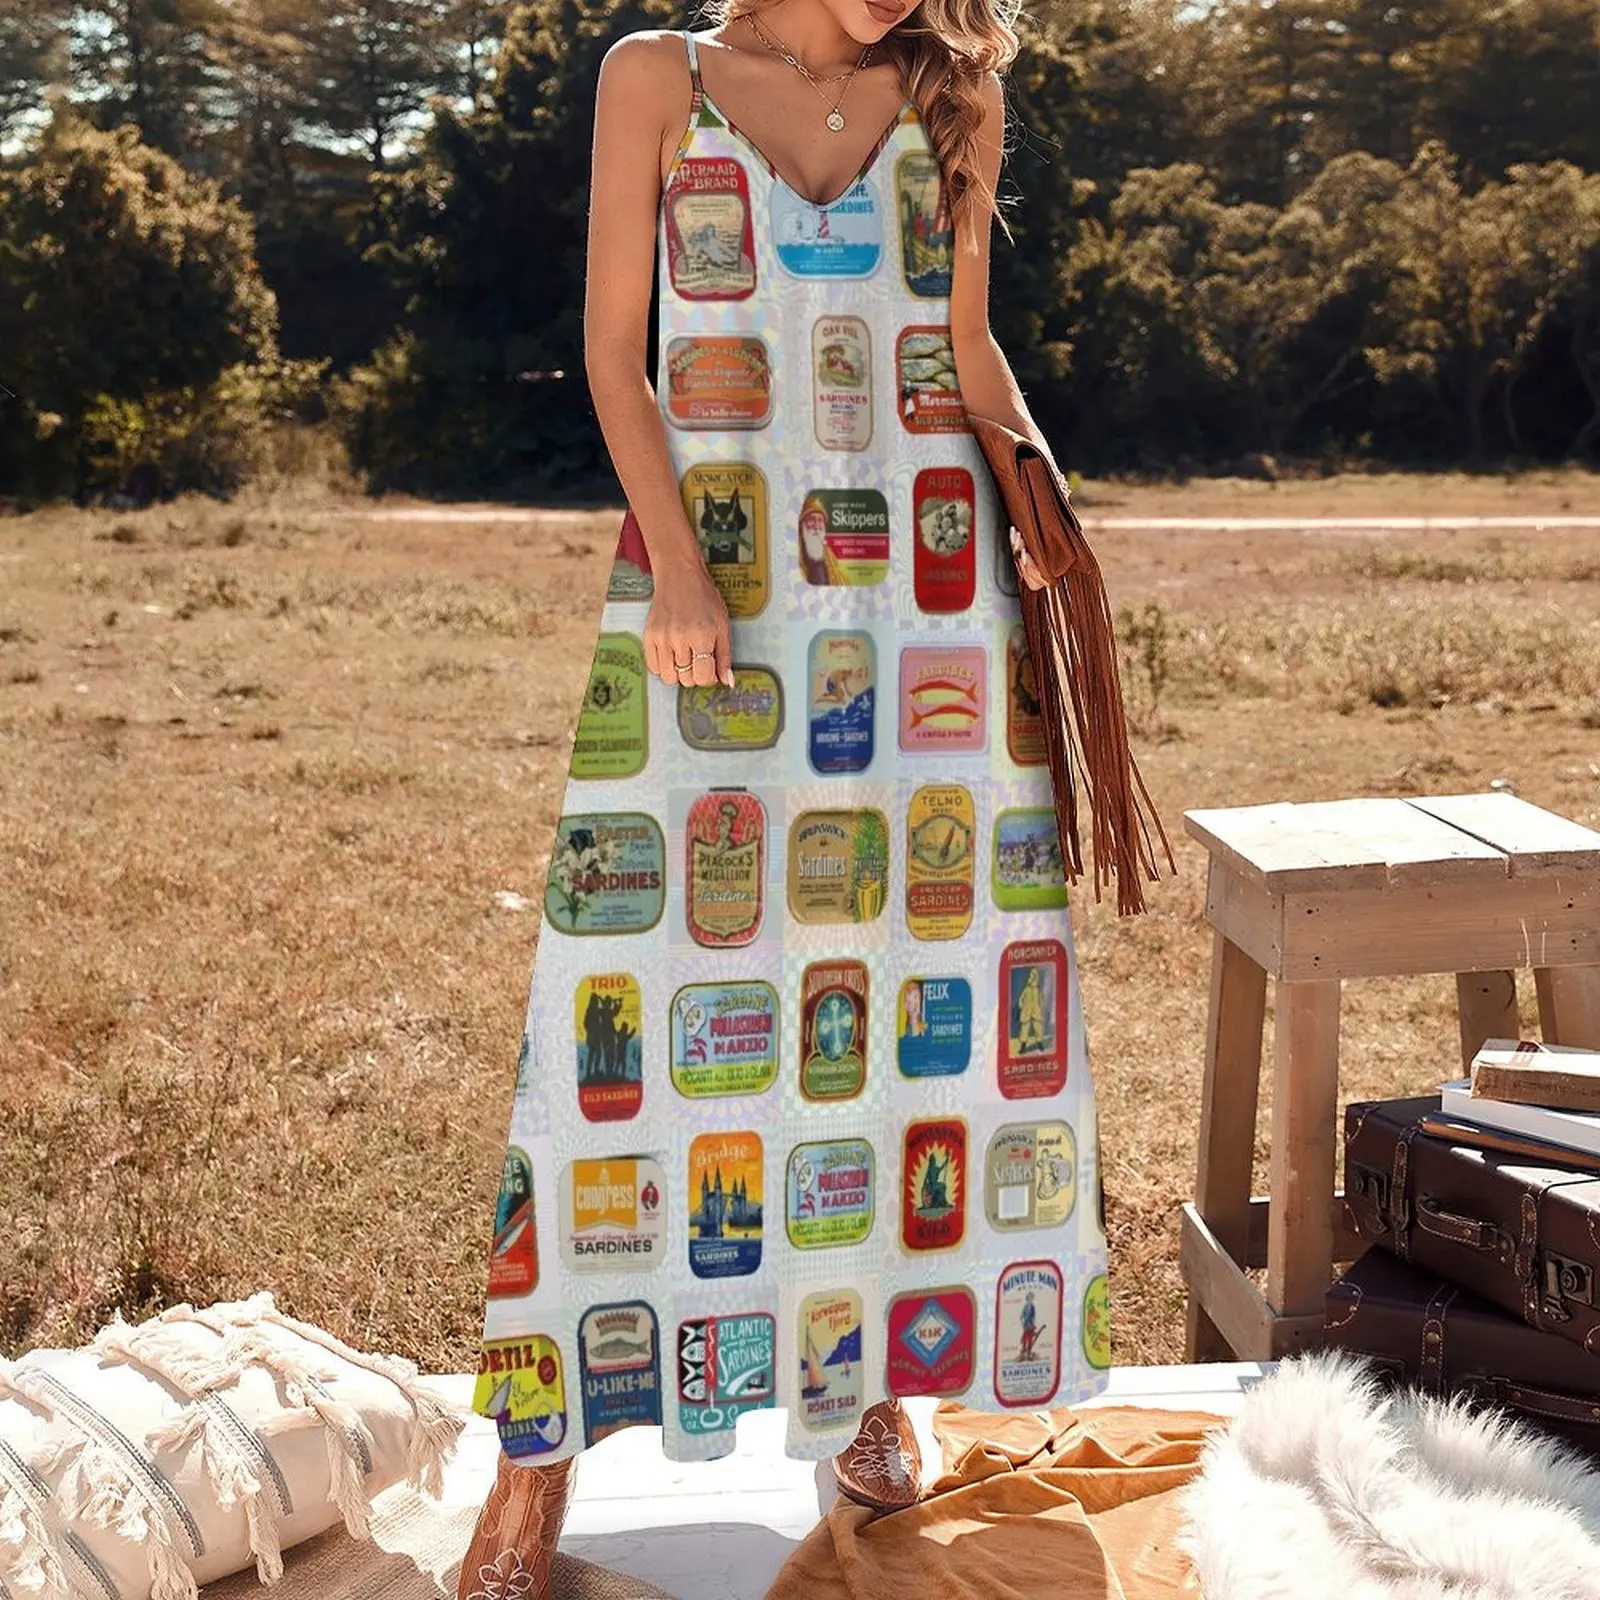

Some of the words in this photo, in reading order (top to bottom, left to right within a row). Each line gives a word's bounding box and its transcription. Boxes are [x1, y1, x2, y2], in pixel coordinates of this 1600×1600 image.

[694, 177, 738, 189] BRAND
[831, 510, 886, 529] Skippers
[921, 795, 963, 806] TELMO
[798, 850, 846, 877] Sardines
[572, 871, 661, 893] SARDINES
[911, 895, 969, 907] SARDINES
[589, 975, 628, 990] TRIO
[923, 982, 949, 1001] FELIX
[1003, 1060, 1059, 1075] SARDINES
[695, 1142, 749, 1168] Bridge
[575, 1183, 635, 1215] congress
[574, 1239, 653, 1255] SARDINES
[1002, 1270, 1036, 1293] MINUTE
[1038, 1271, 1057, 1291] MAN
[719, 1318, 771, 1338] ATLANTIC
[918, 1325, 942, 1339] KIK
[478, 1344, 537, 1375] ORTIZ
[717, 1340, 773, 1388] SARDINES
[1002, 1366, 1051, 1378] SARDINES
[587, 1371, 656, 1397] U-LIKE-ME
